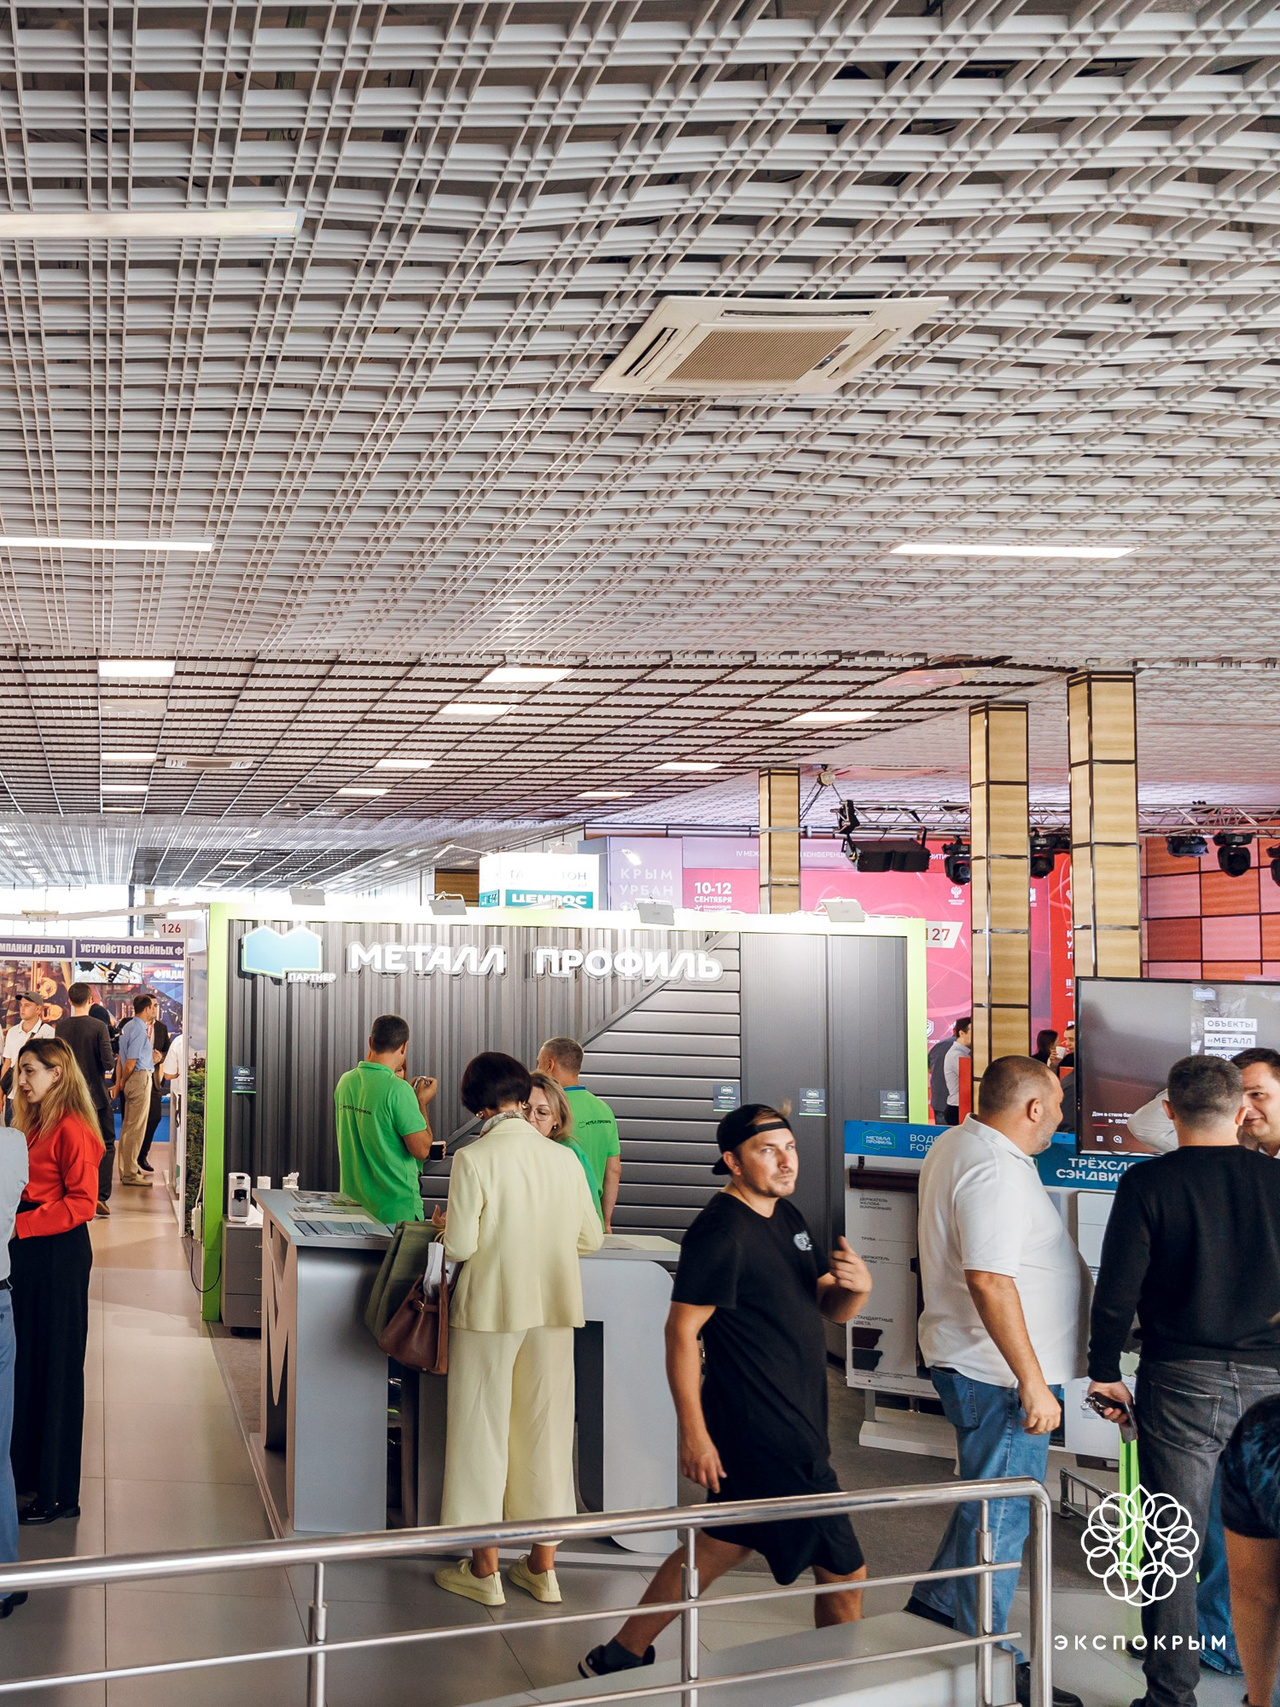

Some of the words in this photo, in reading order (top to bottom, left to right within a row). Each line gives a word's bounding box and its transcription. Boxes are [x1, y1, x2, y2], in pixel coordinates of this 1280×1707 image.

[620, 868, 673, 881] КРЫМ
[619, 884, 674, 897] УРБАН
[694, 881, 732, 895] 10-12
[694, 895, 732, 904] СЕНТЯБРЯ
[161, 923, 182, 934] 126
[33, 944, 66, 955] ДЕЛЬТА
[80, 942, 132, 955] УСТРОЙСТВО
[133, 943, 174, 956] СВАЙНЫХ
[348, 942, 506, 975] МЕТАЛЛ
[535, 946, 723, 981] ПРОФИЛЬ
[287, 971, 336, 983] ПАРТНЕР
[1207, 1019, 1254, 1029] ОБЪЕКТЫ
[1207, 1036, 1252, 1045] «МЕТАЛЛ
[1056, 1168, 1122, 1183] СЭНДВИ
